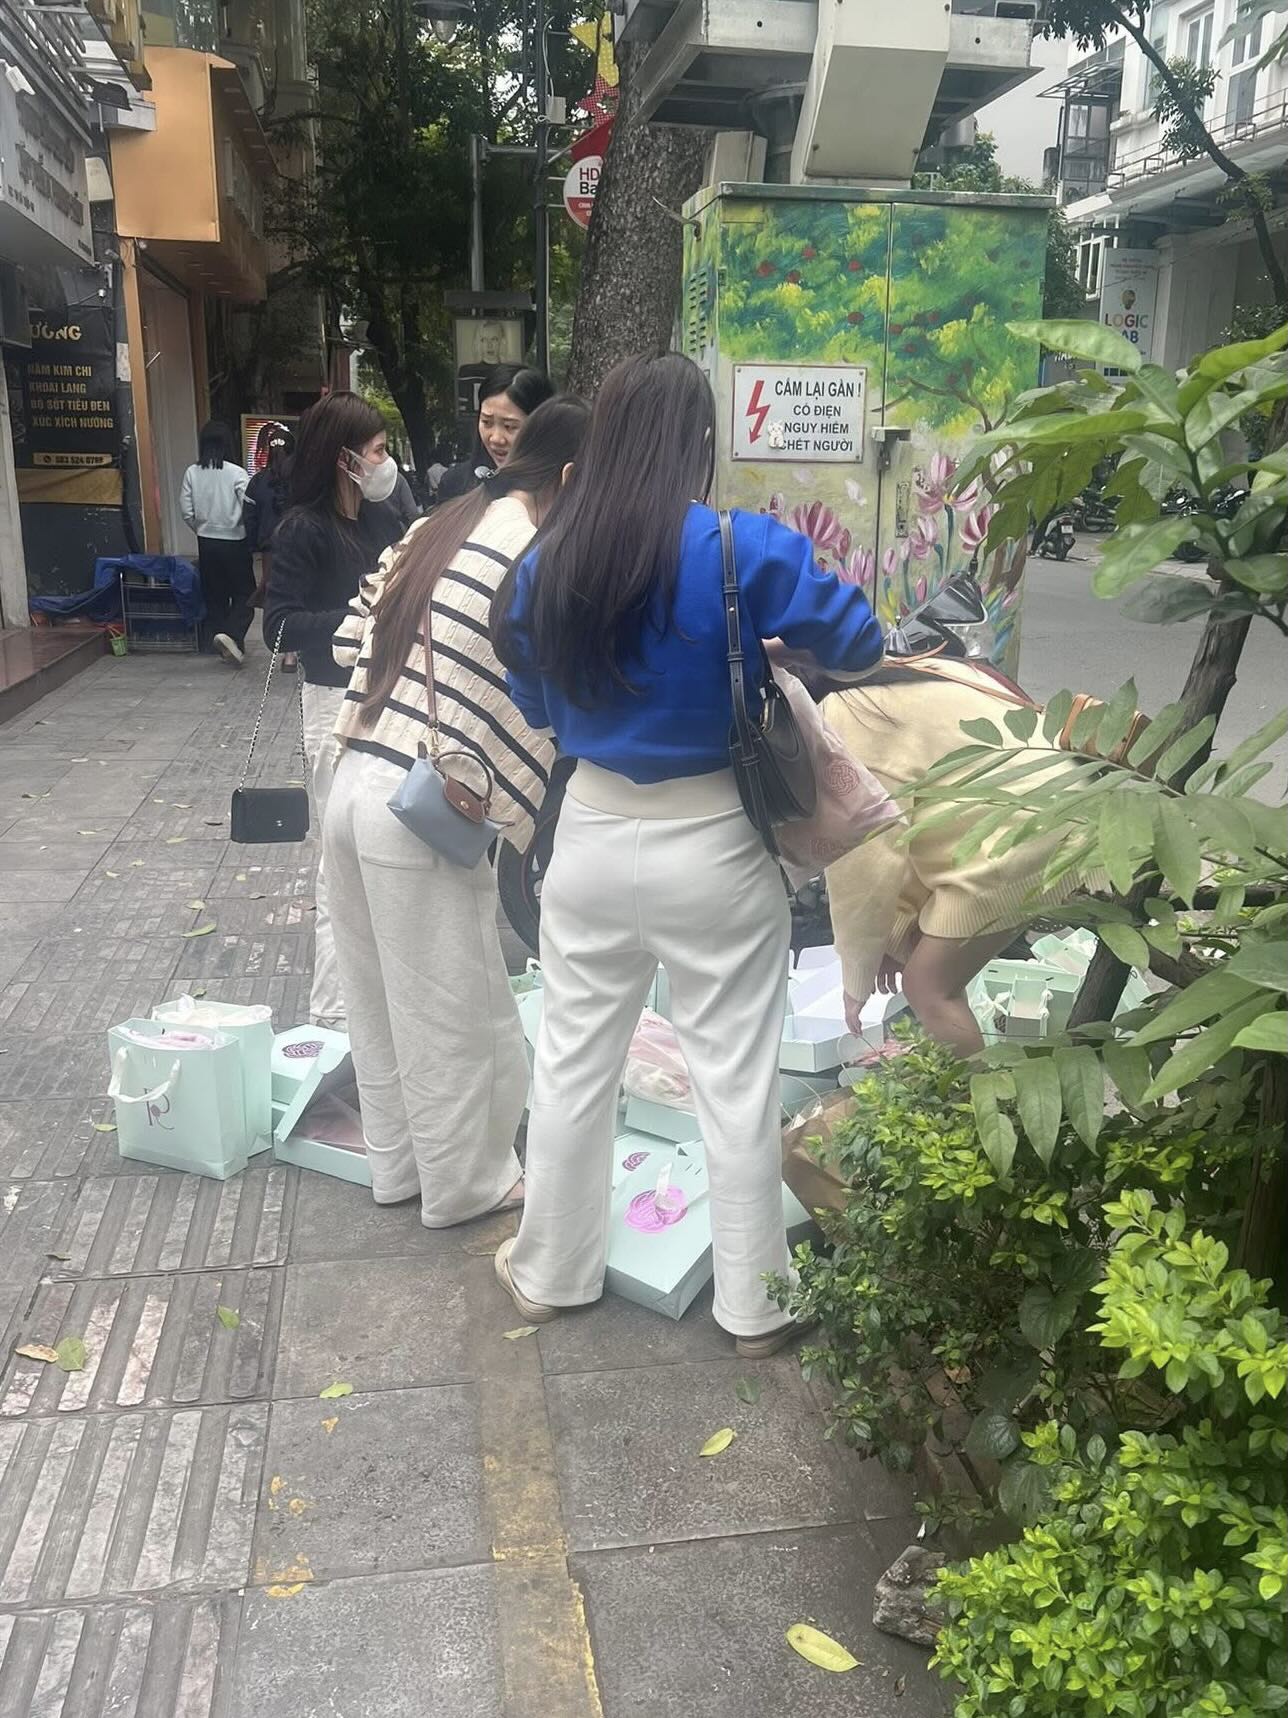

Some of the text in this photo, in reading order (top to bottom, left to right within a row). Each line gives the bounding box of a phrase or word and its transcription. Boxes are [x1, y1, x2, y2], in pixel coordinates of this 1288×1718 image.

[580, 167, 600, 181] HD
[1104, 313, 1149, 329] LOGIC
[75, 365, 92, 377] CHI
[61, 382, 87, 394] LANG
[806, 381, 825, 401] LẠI
[793, 402, 841, 419] CÓ ĐIỆN
[784, 422, 818, 434] NGUY
[813, 439, 853, 452] NGƯỜI
